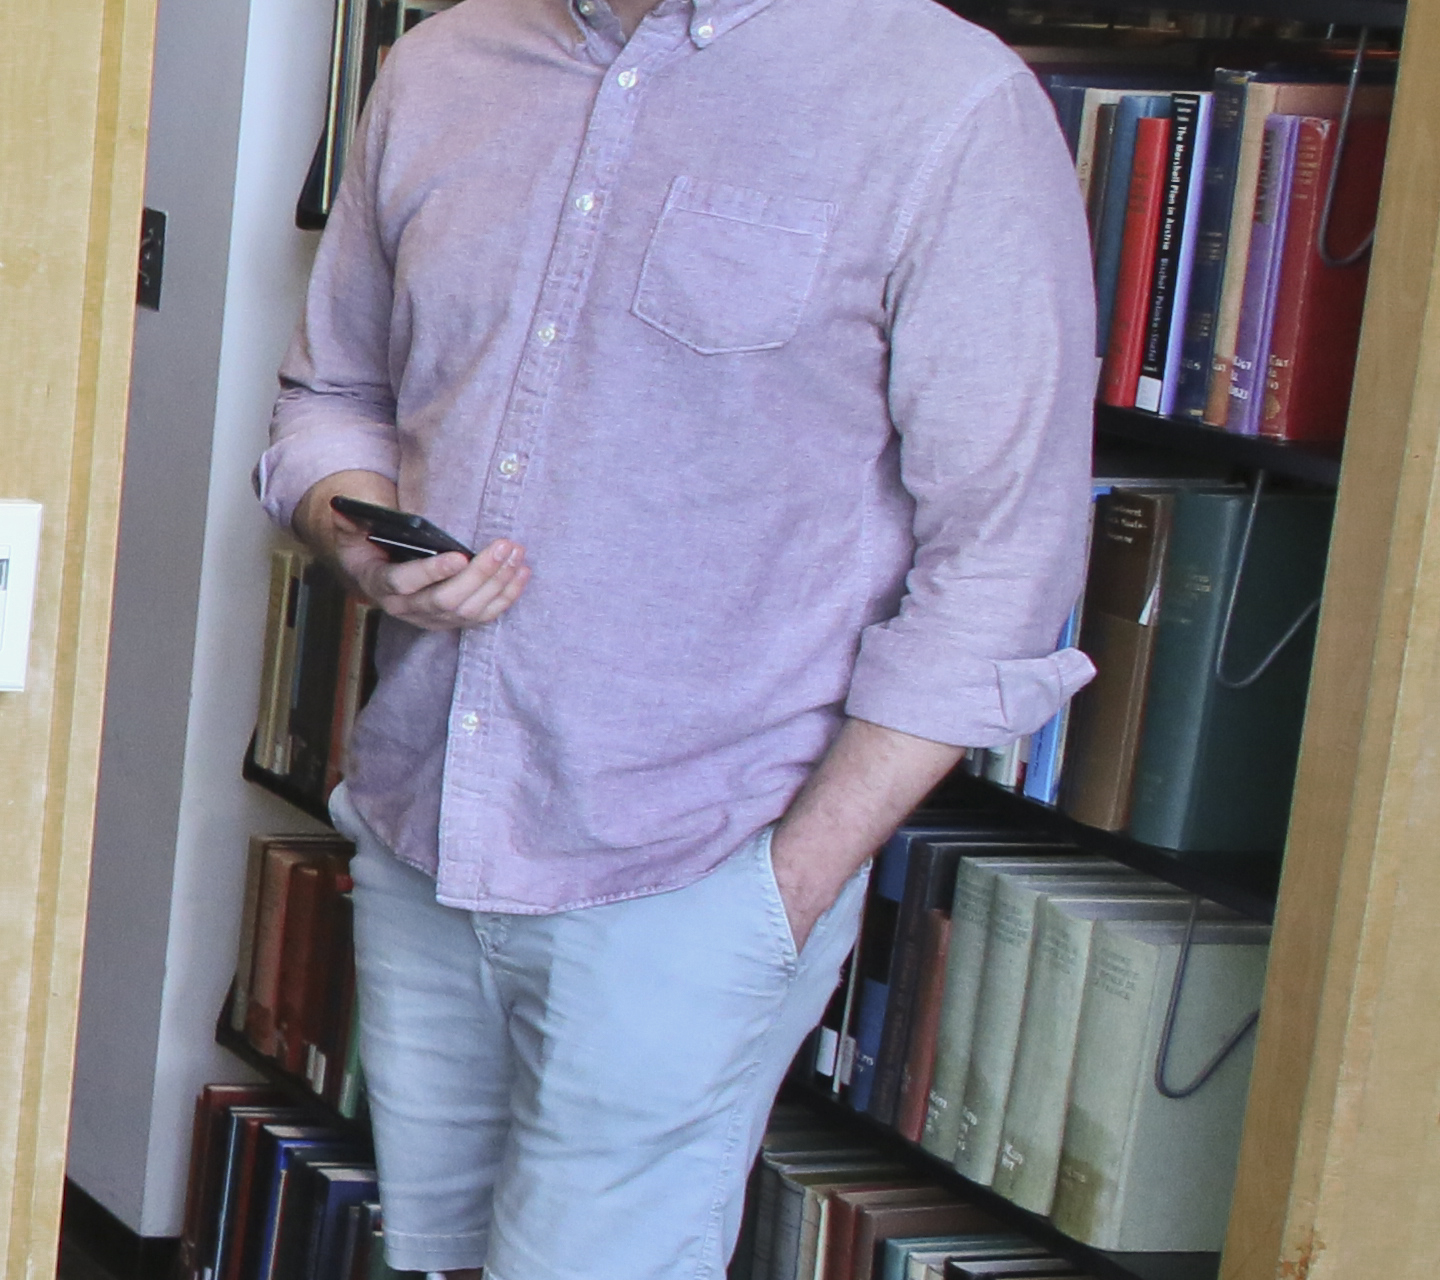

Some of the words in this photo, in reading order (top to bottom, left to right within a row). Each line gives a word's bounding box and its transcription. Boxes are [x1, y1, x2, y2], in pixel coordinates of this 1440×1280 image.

[1177, 125, 1187, 142] The
[1170, 144, 1186, 183] Marshall
[1167, 184, 1179, 204] Plan
[1166, 206, 1176, 215] in
[1161, 218, 1175, 250] Austria
[1157, 258, 1170, 289] Bischof
